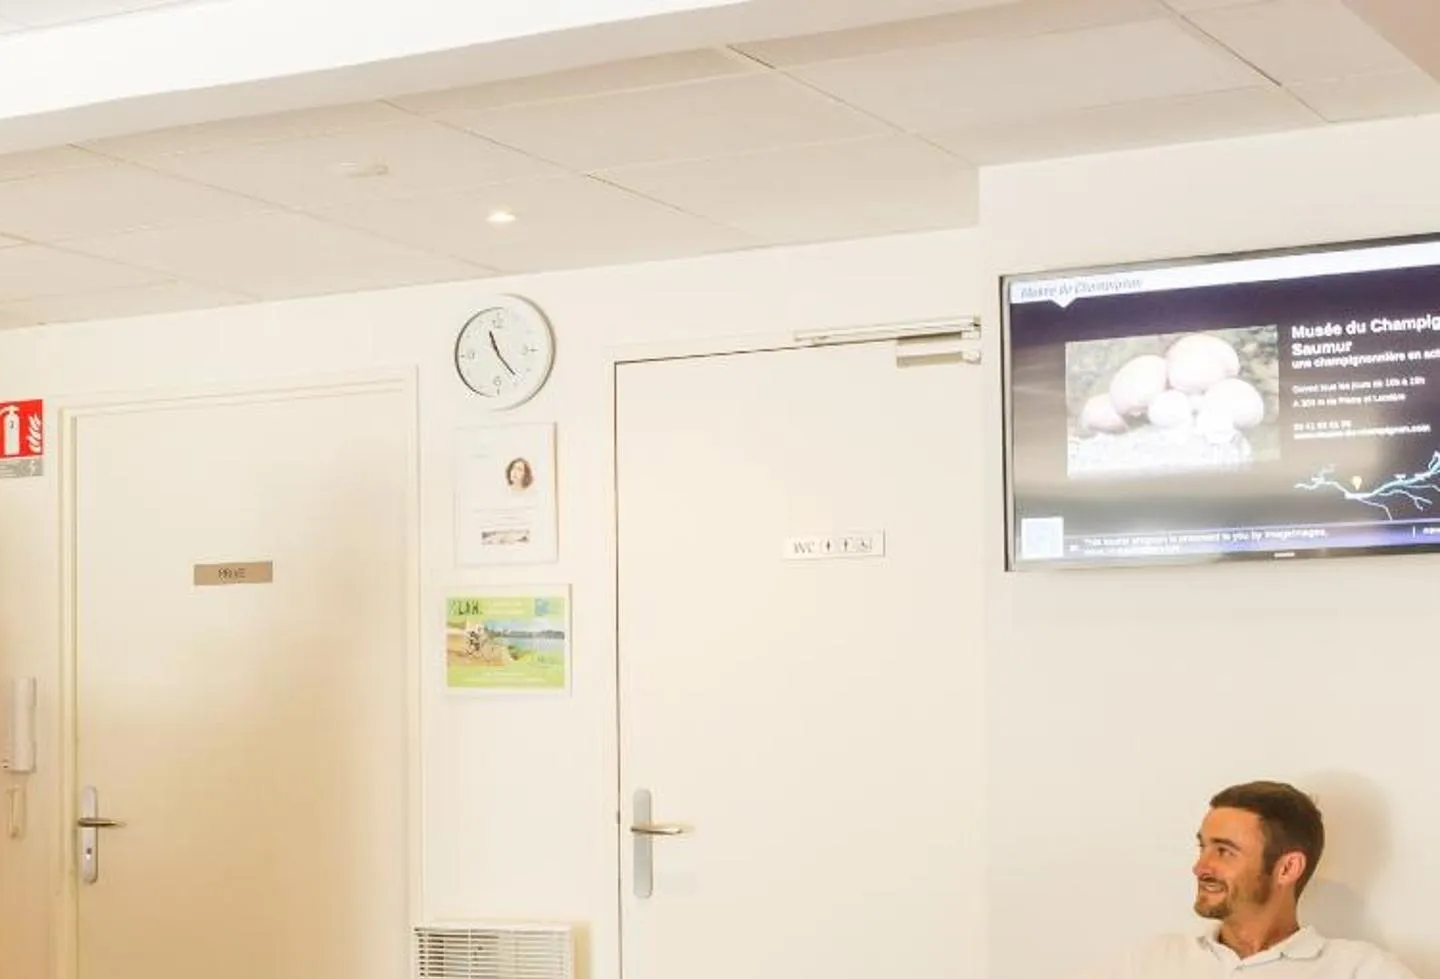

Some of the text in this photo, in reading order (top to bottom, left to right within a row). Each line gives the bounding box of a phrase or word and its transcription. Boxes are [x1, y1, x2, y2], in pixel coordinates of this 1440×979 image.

[1291, 314, 1440, 339] Musée du Champig
[1291, 341, 1352, 356] Saumur
[1292, 359, 1312, 369] une
[1407, 350, 1421, 360] en
